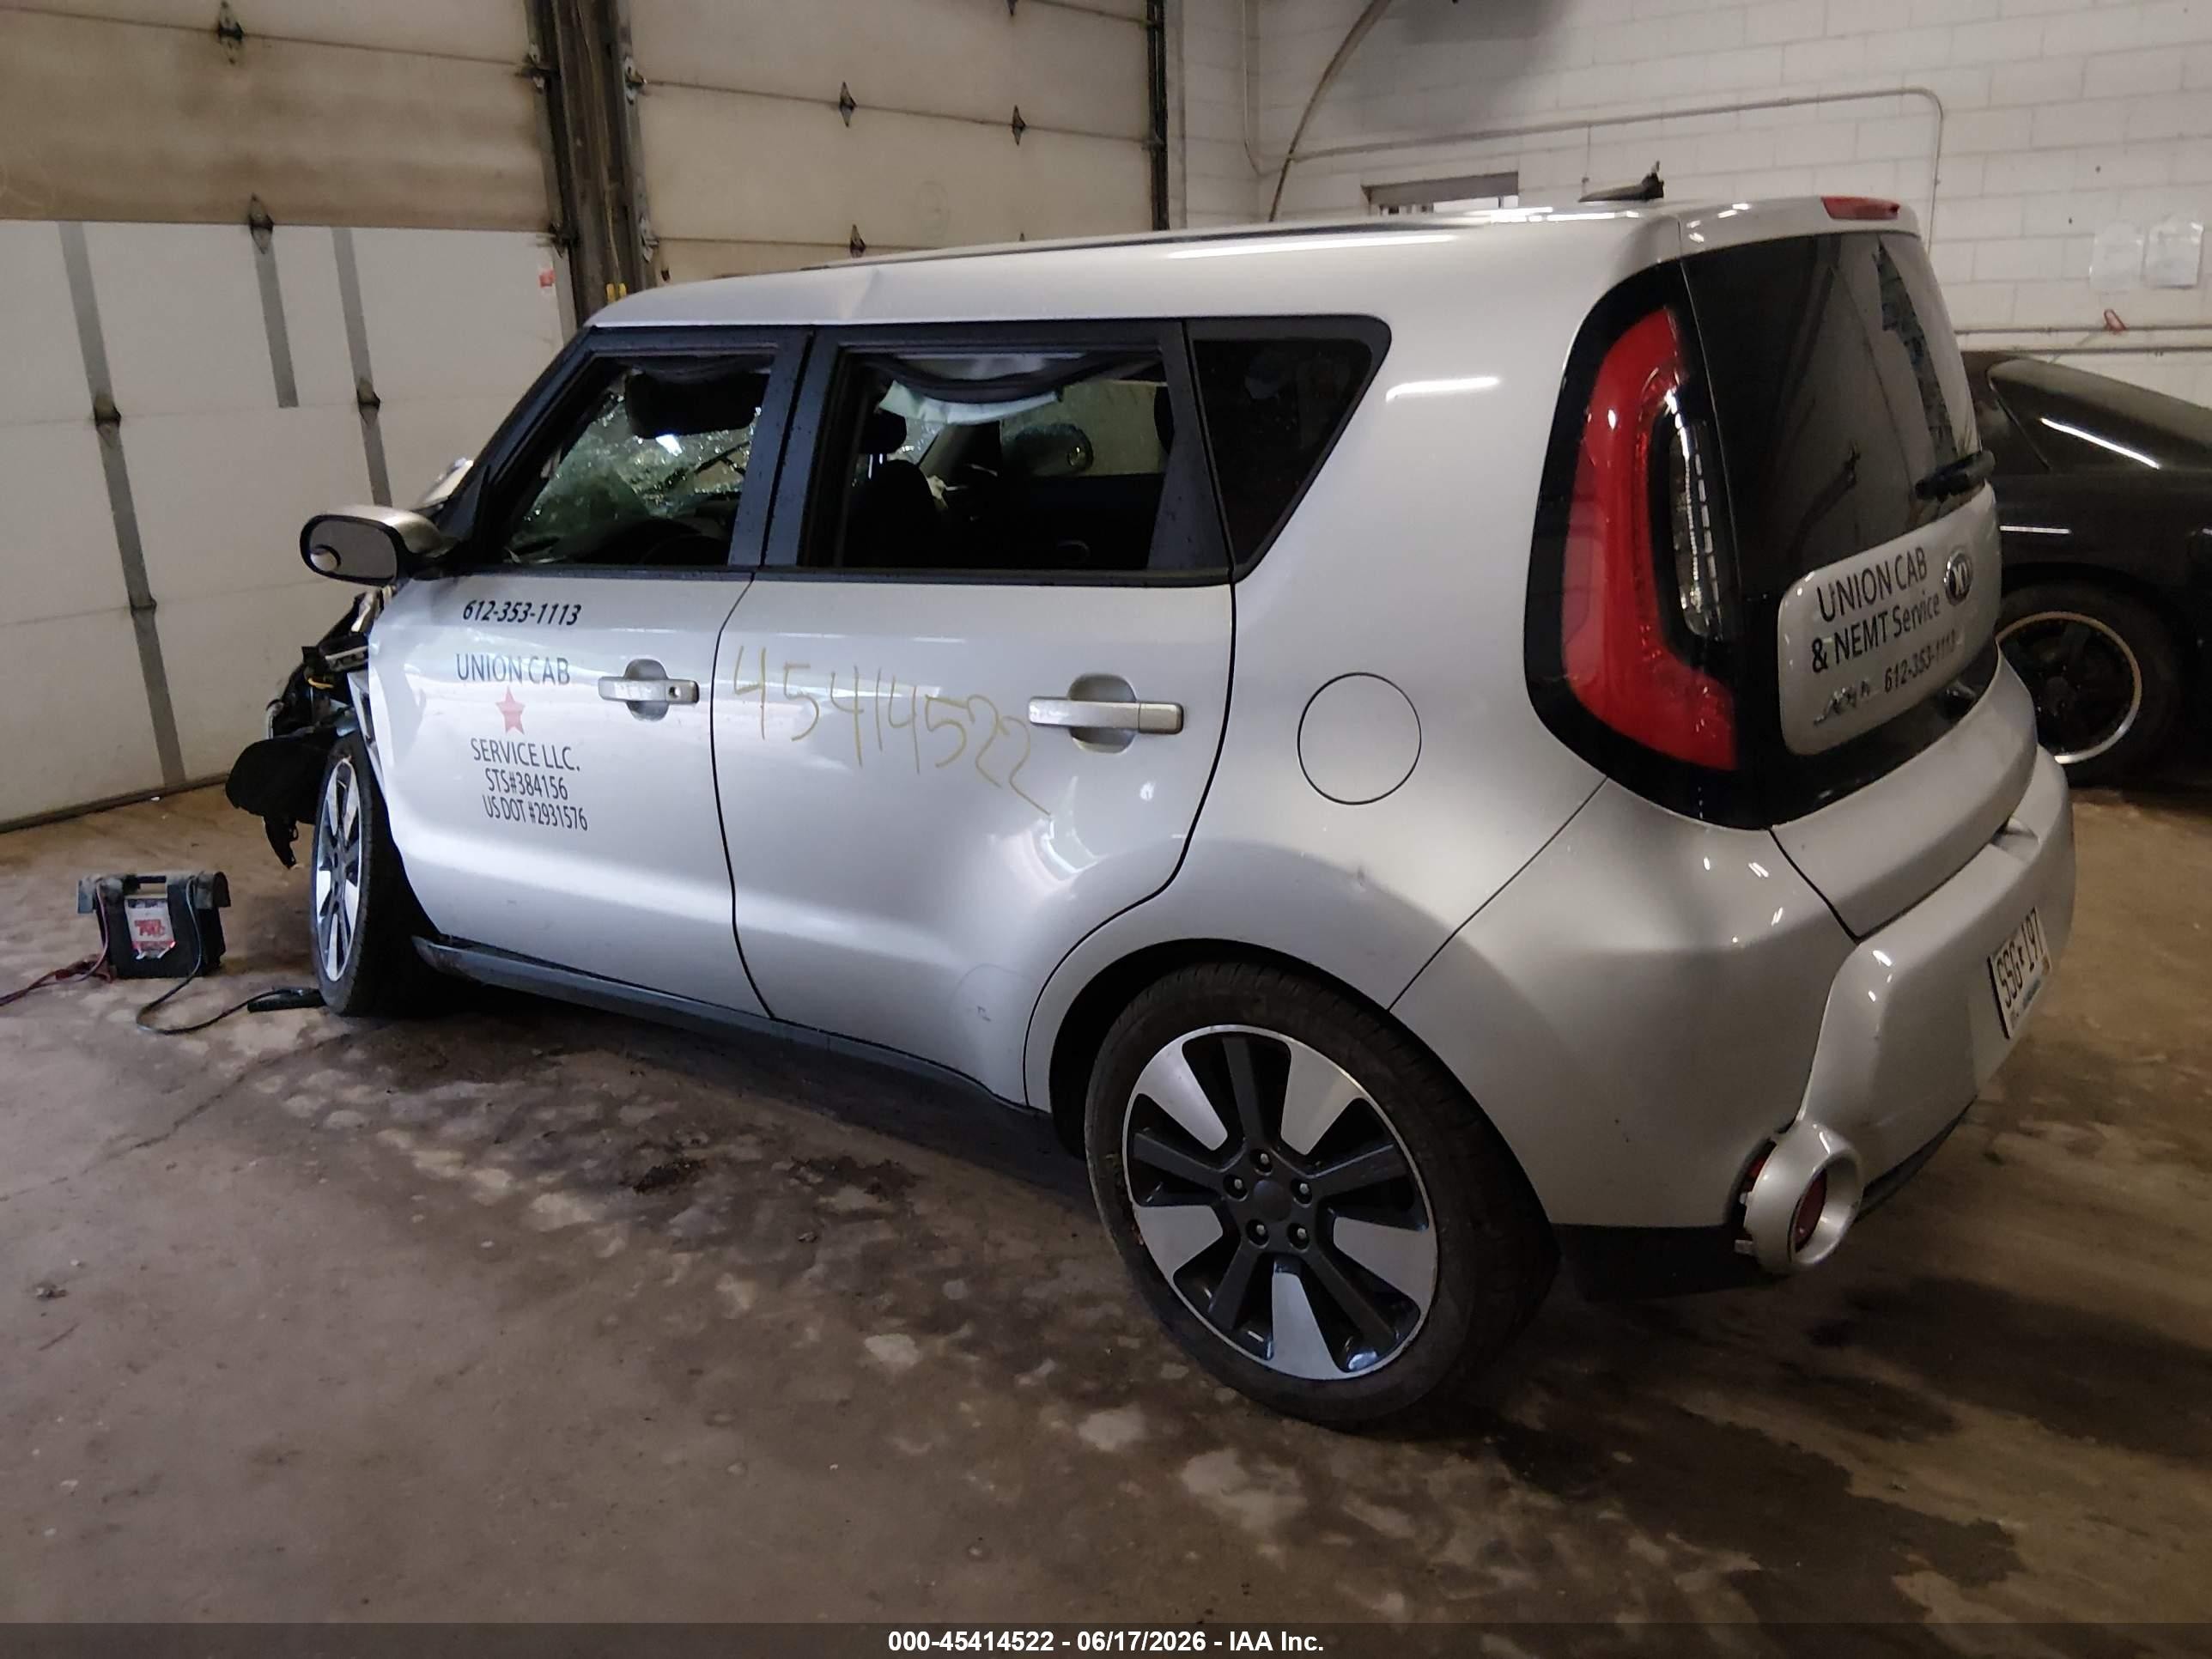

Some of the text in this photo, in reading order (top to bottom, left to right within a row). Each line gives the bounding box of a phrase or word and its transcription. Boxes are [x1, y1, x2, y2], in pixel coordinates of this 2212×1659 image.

[1817, 545, 1927, 623] UNION CAB
[463, 599, 581, 626] 612-353-1113
[1812, 589, 1940, 673] & NEMT Service
[457, 653, 570, 685] UNION CAB
[733, 646, 1050, 816] 45414522
[471, 738, 580, 771] SERVICE LLC.
[485, 769, 568, 800] STS#384156
[483, 794, 588, 831] US DOT #2931576
